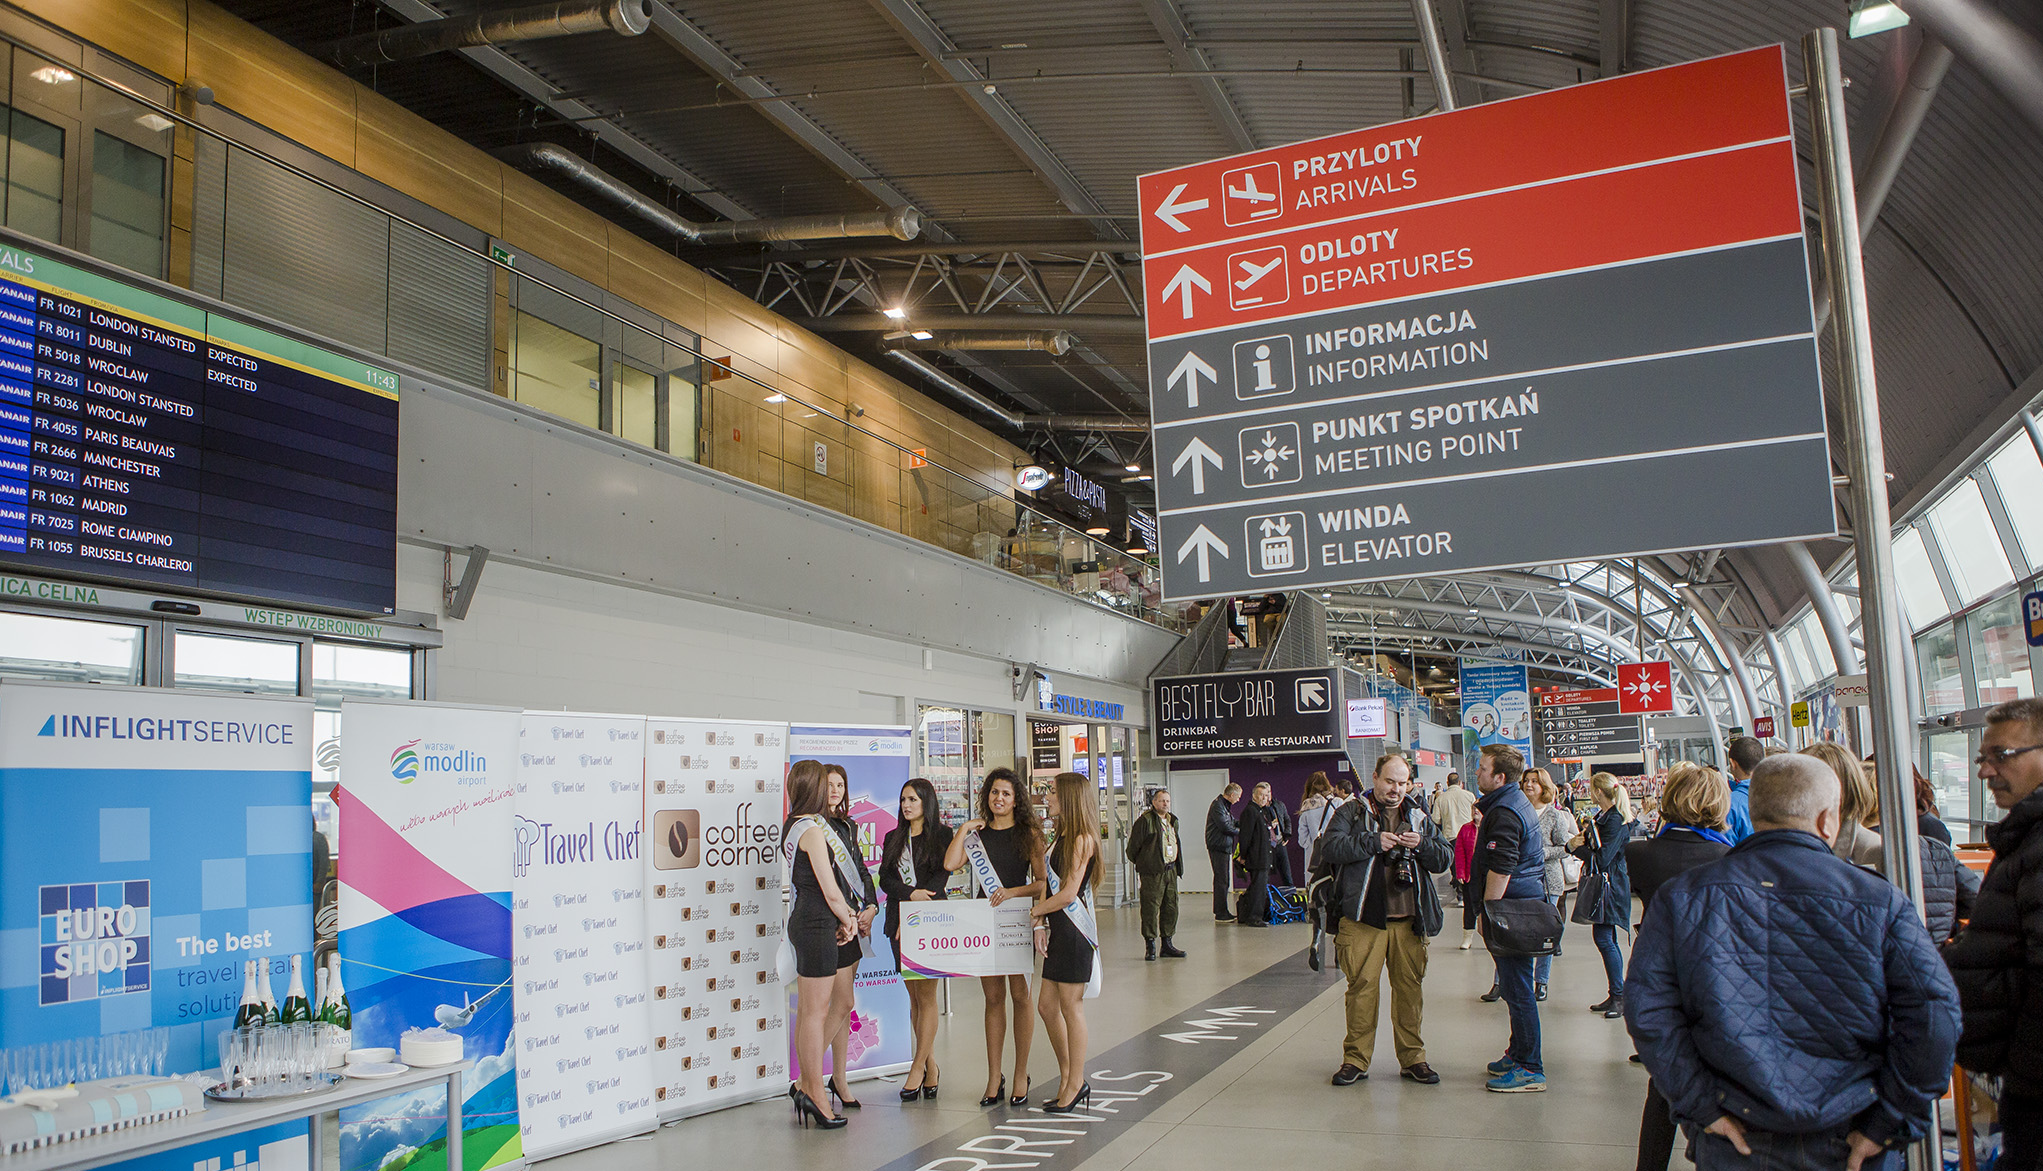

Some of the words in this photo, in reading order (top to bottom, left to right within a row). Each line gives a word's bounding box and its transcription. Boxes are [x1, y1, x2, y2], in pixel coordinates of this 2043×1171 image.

[1293, 135, 1423, 180] PRZYLOTY
[1295, 168, 1418, 211] ARRIVALS
[1300, 228, 1399, 265] ODLOTY
[0, 248, 34, 274] ALS
[1303, 247, 1474, 296] DEPARTURES
[40, 297, 54, 311] FR
[58, 303, 82, 319] 1021
[39, 320, 53, 335] FR
[56, 325, 81, 342] 8011
[89, 311, 139, 337] LONDON
[141, 328, 196, 353] STANSTED
[1305, 309, 1477, 355] INFORMACJA
[38, 344, 52, 358] FR
[55, 349, 81, 365] 5018
[88, 333, 133, 357] DUBLIN
[87, 356, 149, 383] WROCLAW
[208, 348, 258, 372] EXPECTED
[1308, 339, 1489, 387] INFORMATION
[37, 367, 51, 381] FR
[54, 372, 79, 388] 2281
[207, 369, 258, 392] EXPECTED
[366, 370, 395, 390] 11:43
[36, 391, 50, 405] FR
[53, 395, 79, 412] 5036
[86, 379, 136, 403] LONDON
[138, 393, 194, 417] STANSTED
[35, 417, 49, 430] FR
[52, 421, 78, 436] 4055
[86, 402, 148, 428] WROCLAW
[1312, 410, 1402, 444] PUNKT
[1410, 386, 1539, 431] SPOTKAŃ
[34, 441, 48, 454] FR
[51, 445, 77, 460] 2666
[85, 427, 119, 446] PARIS
[121, 435, 176, 459] BEAUVAIS
[1315, 440, 1431, 476] MEETING
[1442, 427, 1523, 460] POINT
[33, 465, 47, 478] FR
[50, 468, 75, 483] 9021
[83, 450, 161, 478] MANCHESTER
[82, 474, 130, 494] ATHENS
[32, 489, 46, 502] FR
[49, 493, 75, 508] 1062
[81, 497, 128, 516] MADRID
[31, 513, 45, 526] FR
[48, 516, 74, 531] 7025
[1318, 503, 1411, 534] WINDA
[81, 520, 115, 538] ROME
[118, 527, 173, 547] CIAMPINO
[30, 537, 45, 550] FR
[48, 540, 73, 554] 1055
[1322, 531, 1453, 567] ELEVATOR
[80, 545, 133, 564] BRUSSELS
[136, 553, 193, 572] CHARLEROI
[38, 582, 100, 605] CELNA
[297, 615, 383, 638] WZBRONIONY
[1056, 693, 1084, 717] STYLE
[1086, 698, 1092, 718] &
[1094, 700, 1125, 720] BEAUTY
[1161, 684, 1199, 721] BEST
[1245, 679, 1275, 717] BAR
[1472, 716, 1479, 724] 6
[1757, 721, 1772, 732] AVIS
[1792, 709, 1808, 721] Hertz
[62, 714, 294, 745] INFLIGHTSERVICE
[1035, 726, 1059, 734] SHOP
[1163, 726, 1217, 737] DRINKBAR
[424, 742, 455, 751] warsaw
[880, 742, 903, 750] modlin
[1163, 740, 1203, 750] COFFEE
[1207, 738, 1244, 749] HOUSE
[1248, 738, 1256, 747] &
[1260, 734, 1332, 746] RESTAURANT
[424, 750, 487, 773] modlin
[457, 775, 487, 787] airport
[705, 802, 779, 845] coffee
[540, 822, 594, 864] Travel
[604, 820, 640, 862] Chef
[705, 843, 781, 867] corner
[984, 876, 999, 894] 00
[56, 904, 138, 942] EURO
[923, 913, 954, 923] modlin
[176, 935, 219, 957] The
[225, 930, 272, 952] best
[918, 938, 926, 950] 5
[931, 937, 958, 949] 000
[963, 935, 990, 948] 000
[55, 939, 138, 979] SHOP
[178, 961, 237, 987] travel
[865, 978, 898, 987] WARSAW
